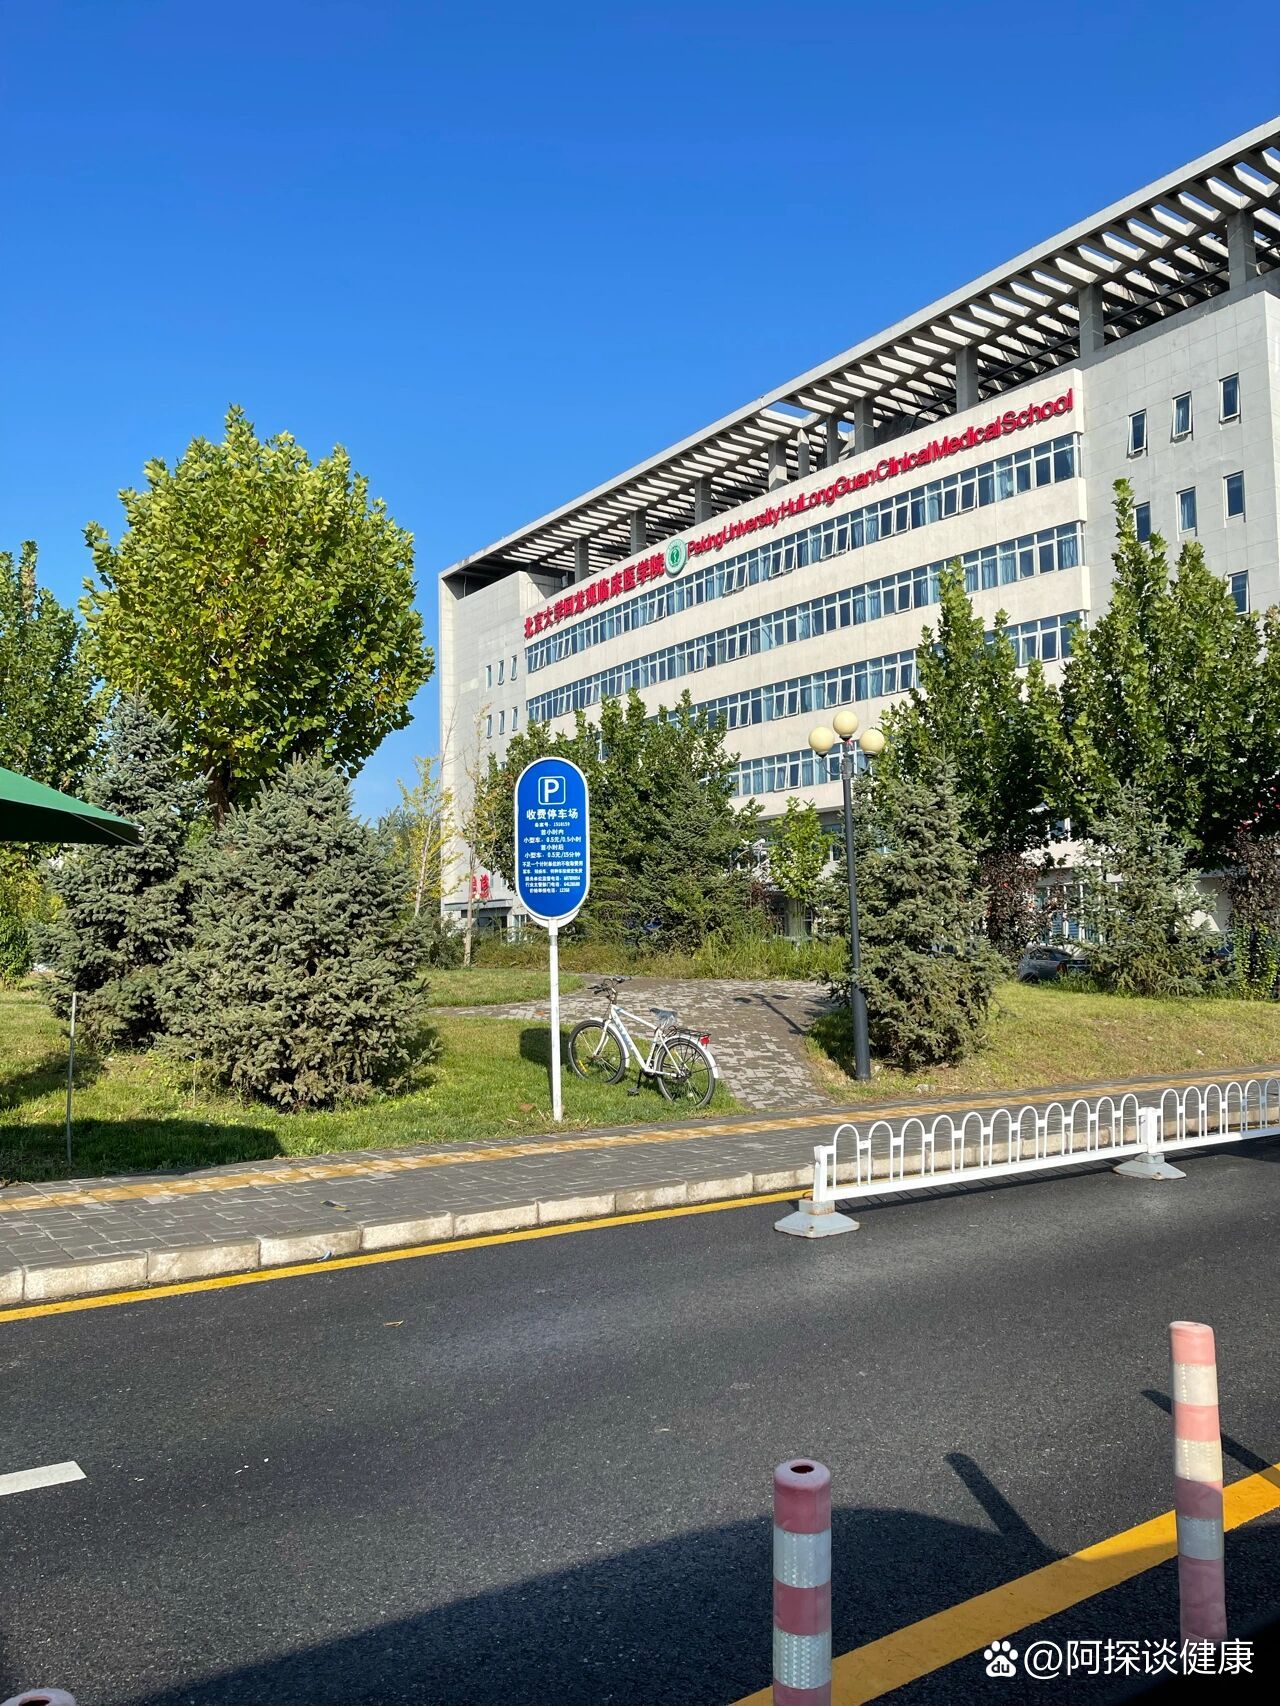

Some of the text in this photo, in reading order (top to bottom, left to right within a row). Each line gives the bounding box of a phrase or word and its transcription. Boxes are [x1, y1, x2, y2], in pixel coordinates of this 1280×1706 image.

[687, 530, 726, 558] Peking
[722, 503, 782, 546] University
[875, 441, 933, 481] Clinical
[930, 415, 1001, 461] Medical
[1000, 387, 1074, 435] School
[524, 552, 665, 638] 北京大学回龙观临床医学院
[543, 778, 560, 803] P
[526, 808, 579, 820] 收费停车场
[540, 844, 565, 852] 首小时后
